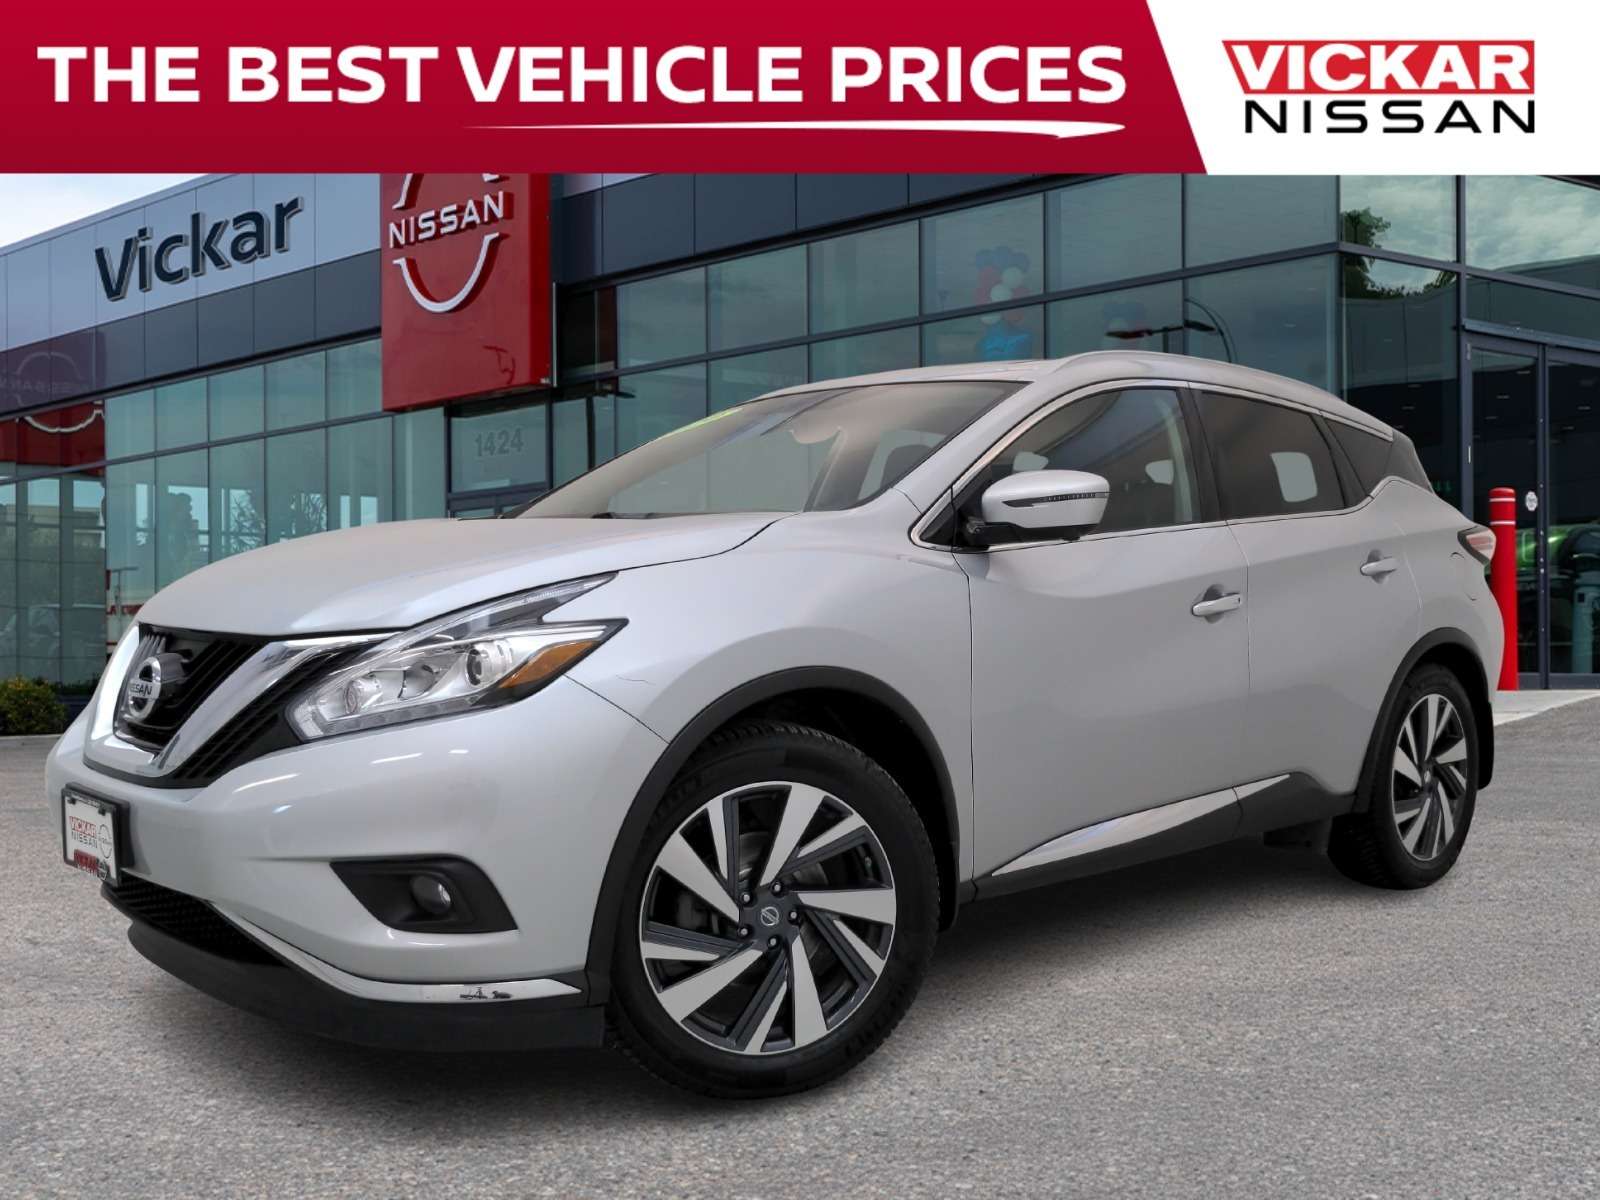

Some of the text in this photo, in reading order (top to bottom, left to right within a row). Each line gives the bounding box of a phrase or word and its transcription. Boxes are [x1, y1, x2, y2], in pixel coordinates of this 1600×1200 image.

[95, 196, 304, 302] Vickar
[388, 190, 506, 249] NISSAN
[475, 427, 525, 457] 1424
